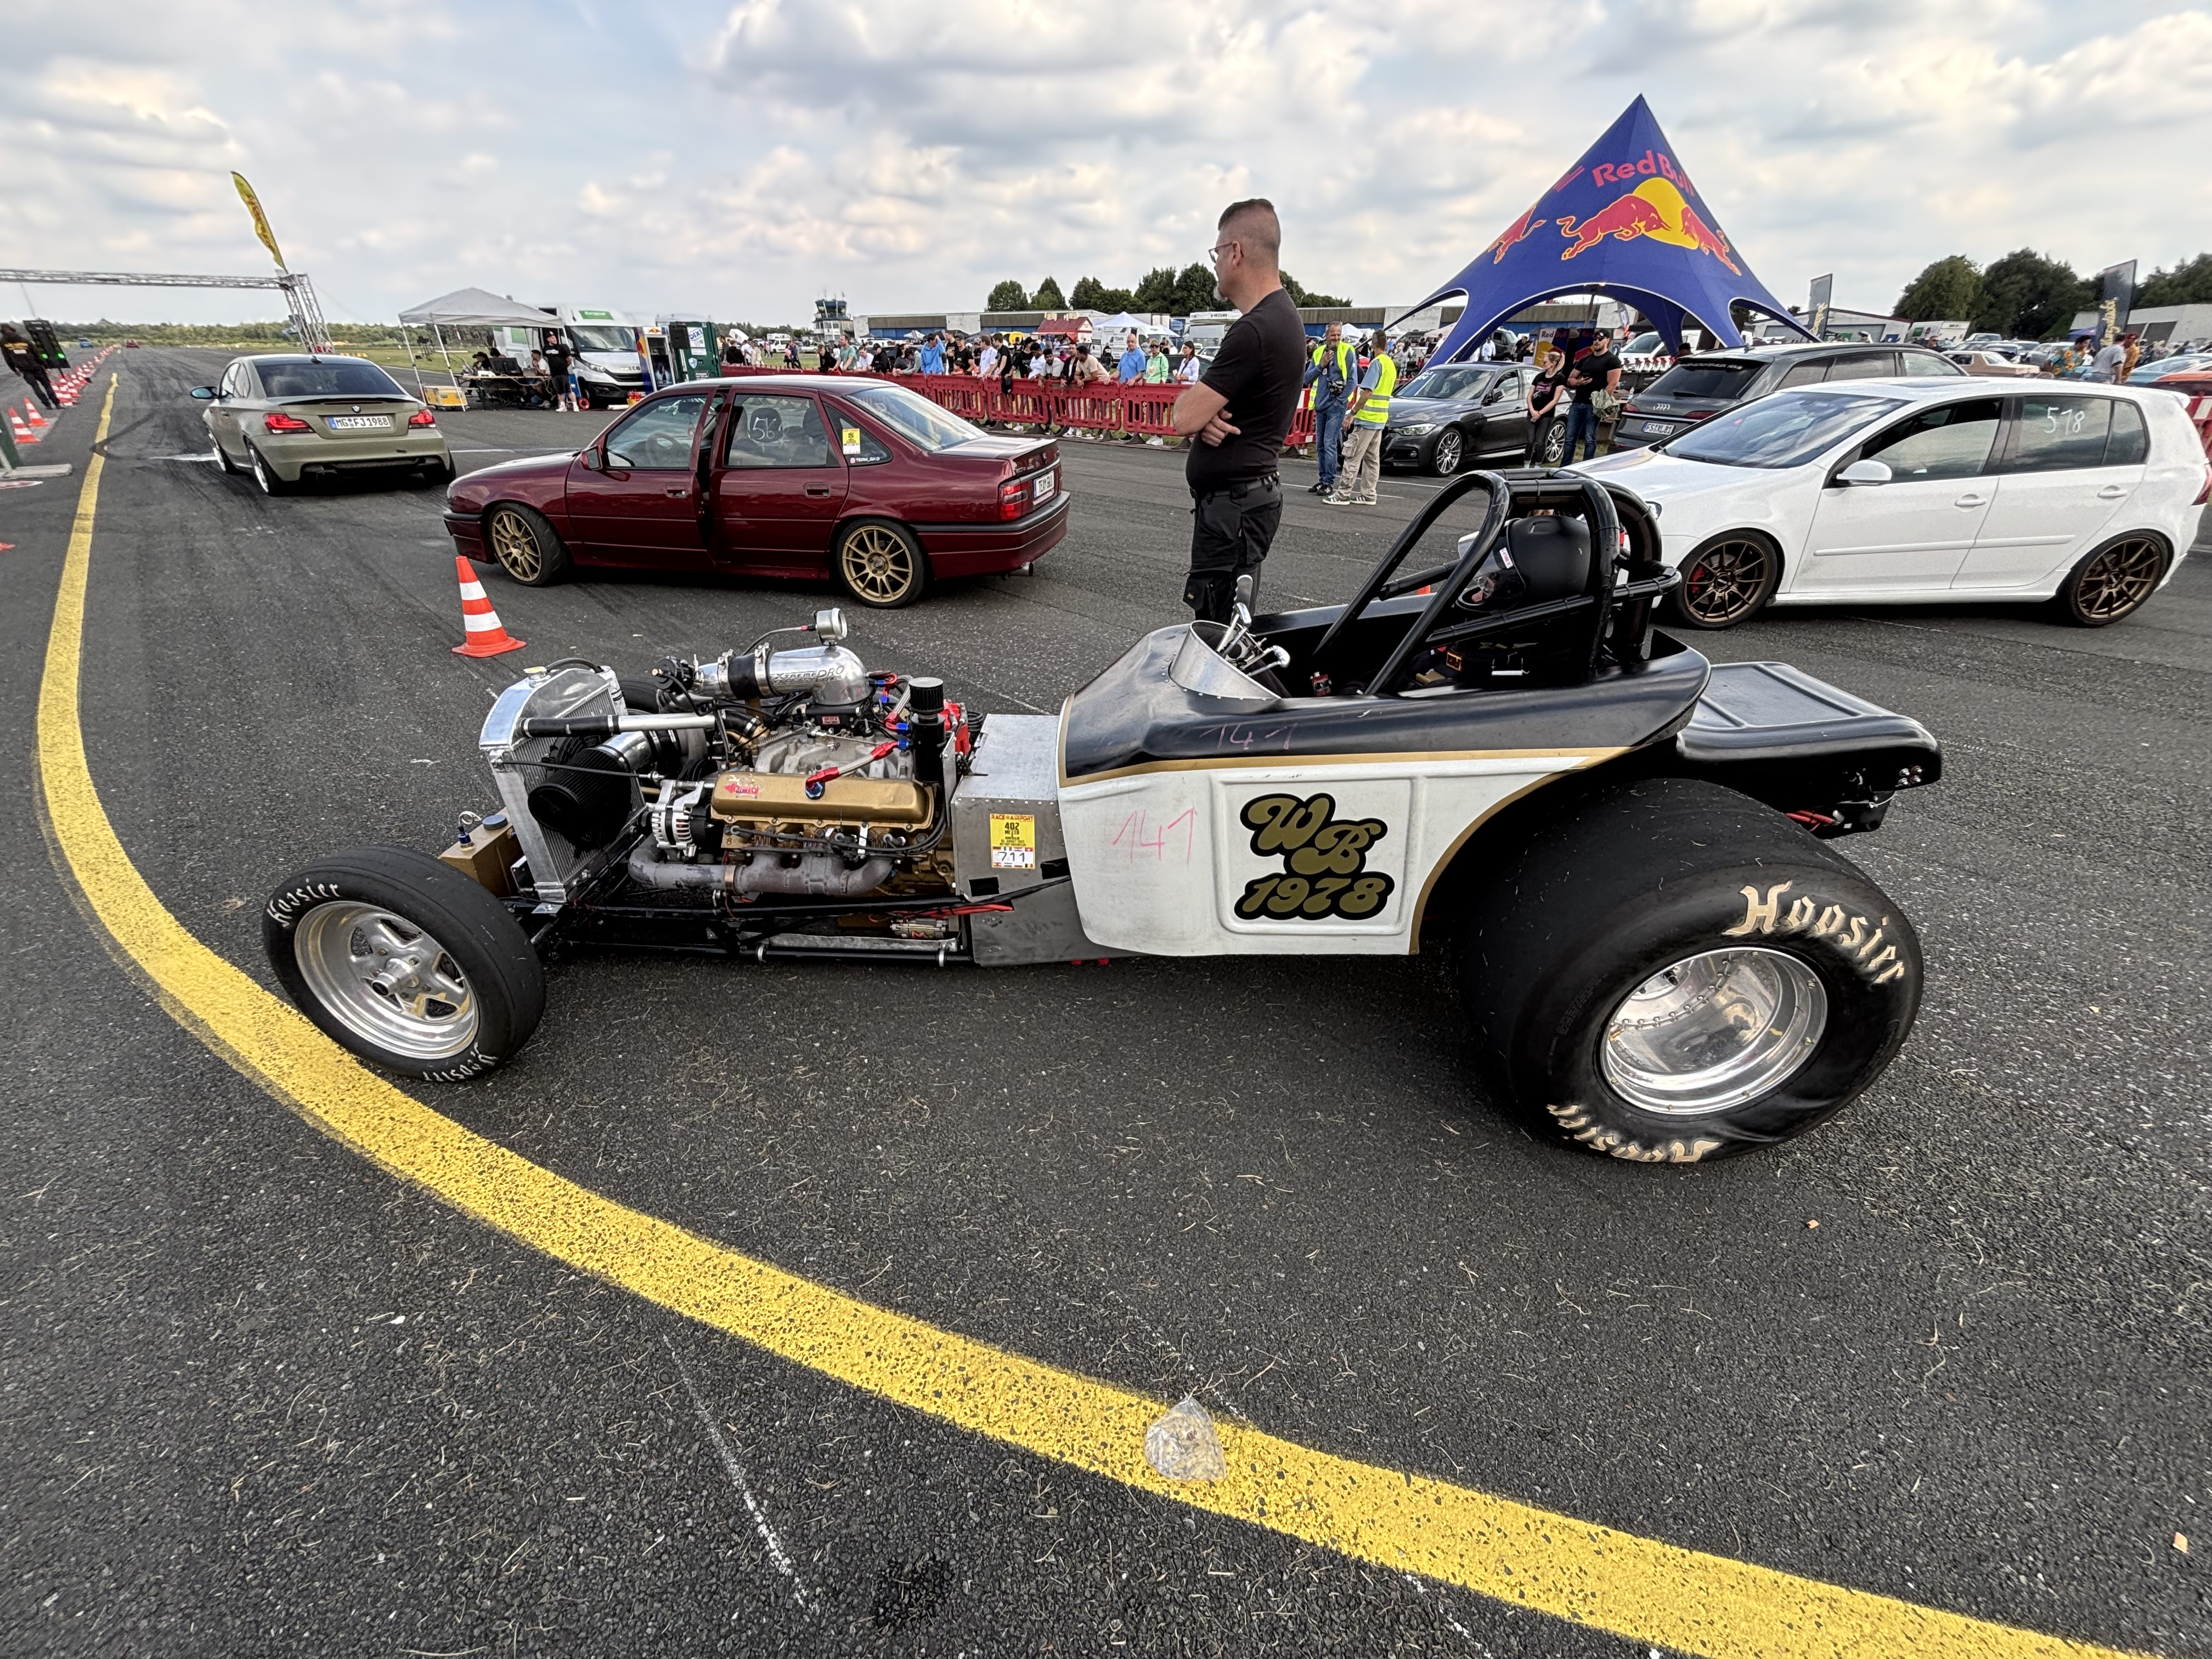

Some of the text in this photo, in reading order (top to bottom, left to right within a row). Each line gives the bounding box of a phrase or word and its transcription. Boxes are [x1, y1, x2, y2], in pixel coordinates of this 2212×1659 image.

[1592, 150, 1657, 187] Red
[689, 329, 703, 340] DIXI
[335, 419, 349, 427] MG
[1005, 822, 1020, 830] 402
[1112, 807, 1194, 865] 141
[726, 837, 732, 845] 8
[997, 851, 1025, 862] 711
[267, 878, 341, 928] Hoosier
[1237, 874, 1392, 917] 1978
[1722, 880, 1905, 983] Hoosier
